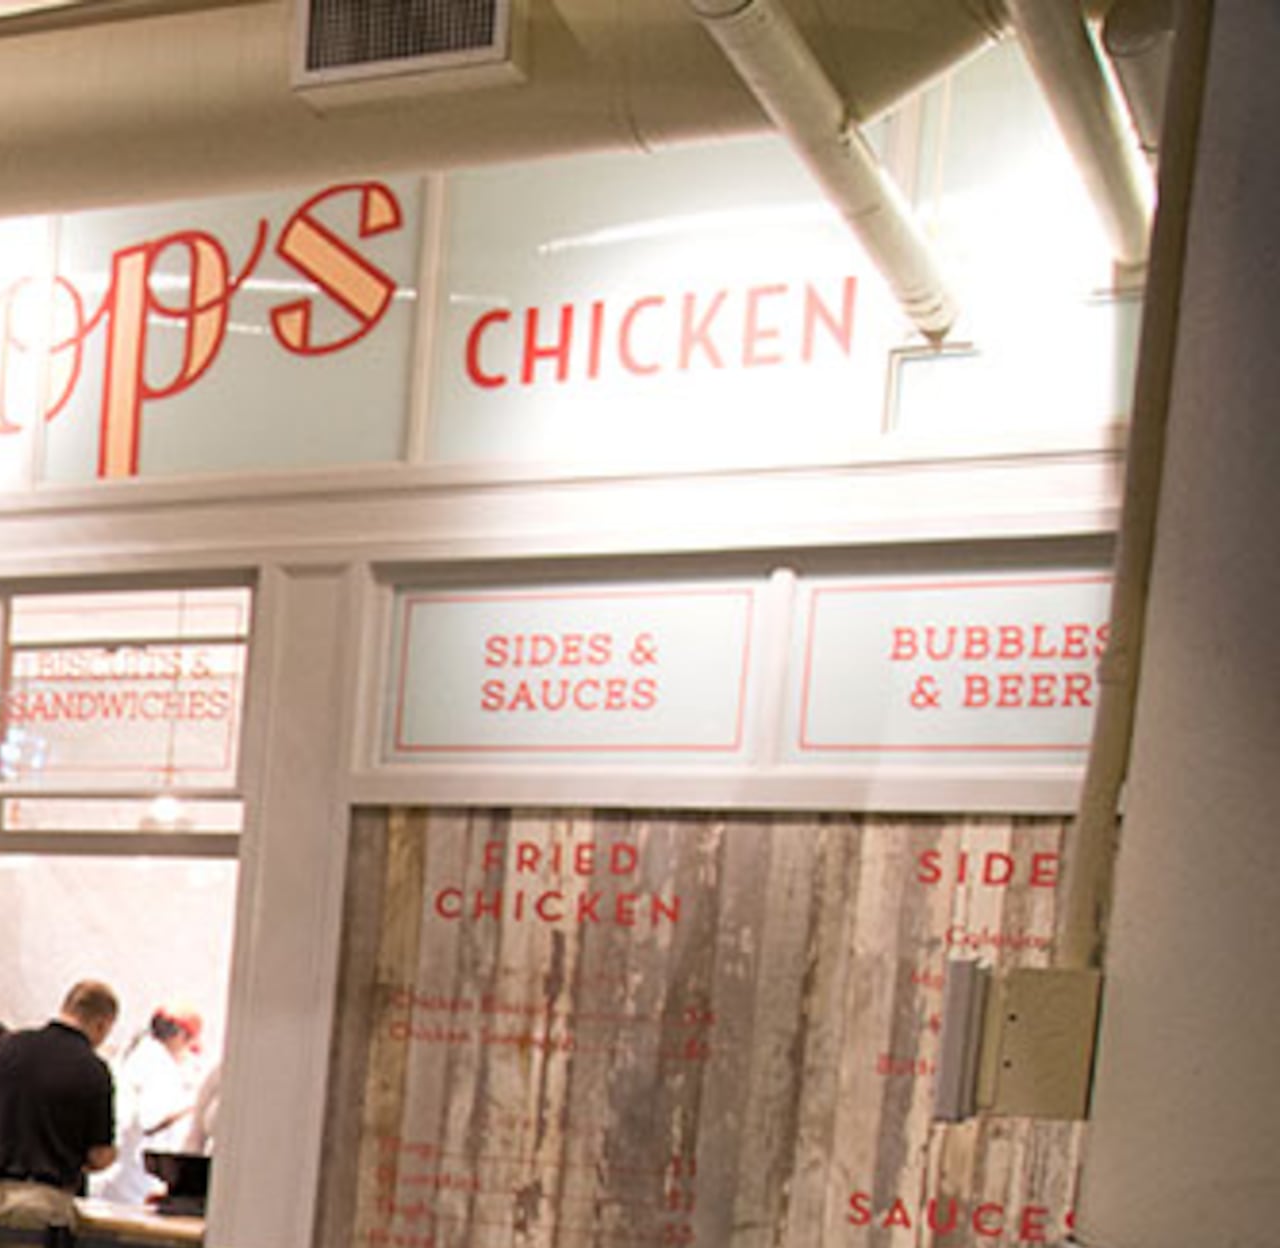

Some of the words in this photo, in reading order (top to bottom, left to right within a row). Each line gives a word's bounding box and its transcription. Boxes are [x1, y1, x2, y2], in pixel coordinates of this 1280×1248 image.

[464, 275, 858, 388] CHICKEN
[484, 634, 613, 667] SIDES
[629, 633, 658, 666] &
[8, 689, 228, 724] SANDWICHES
[480, 679, 658, 711] SAUCES
[909, 675, 941, 708] &
[963, 674, 1093, 708] BEER
[481, 841, 639, 877] FRIED
[434, 887, 684, 929] CHICKEN
